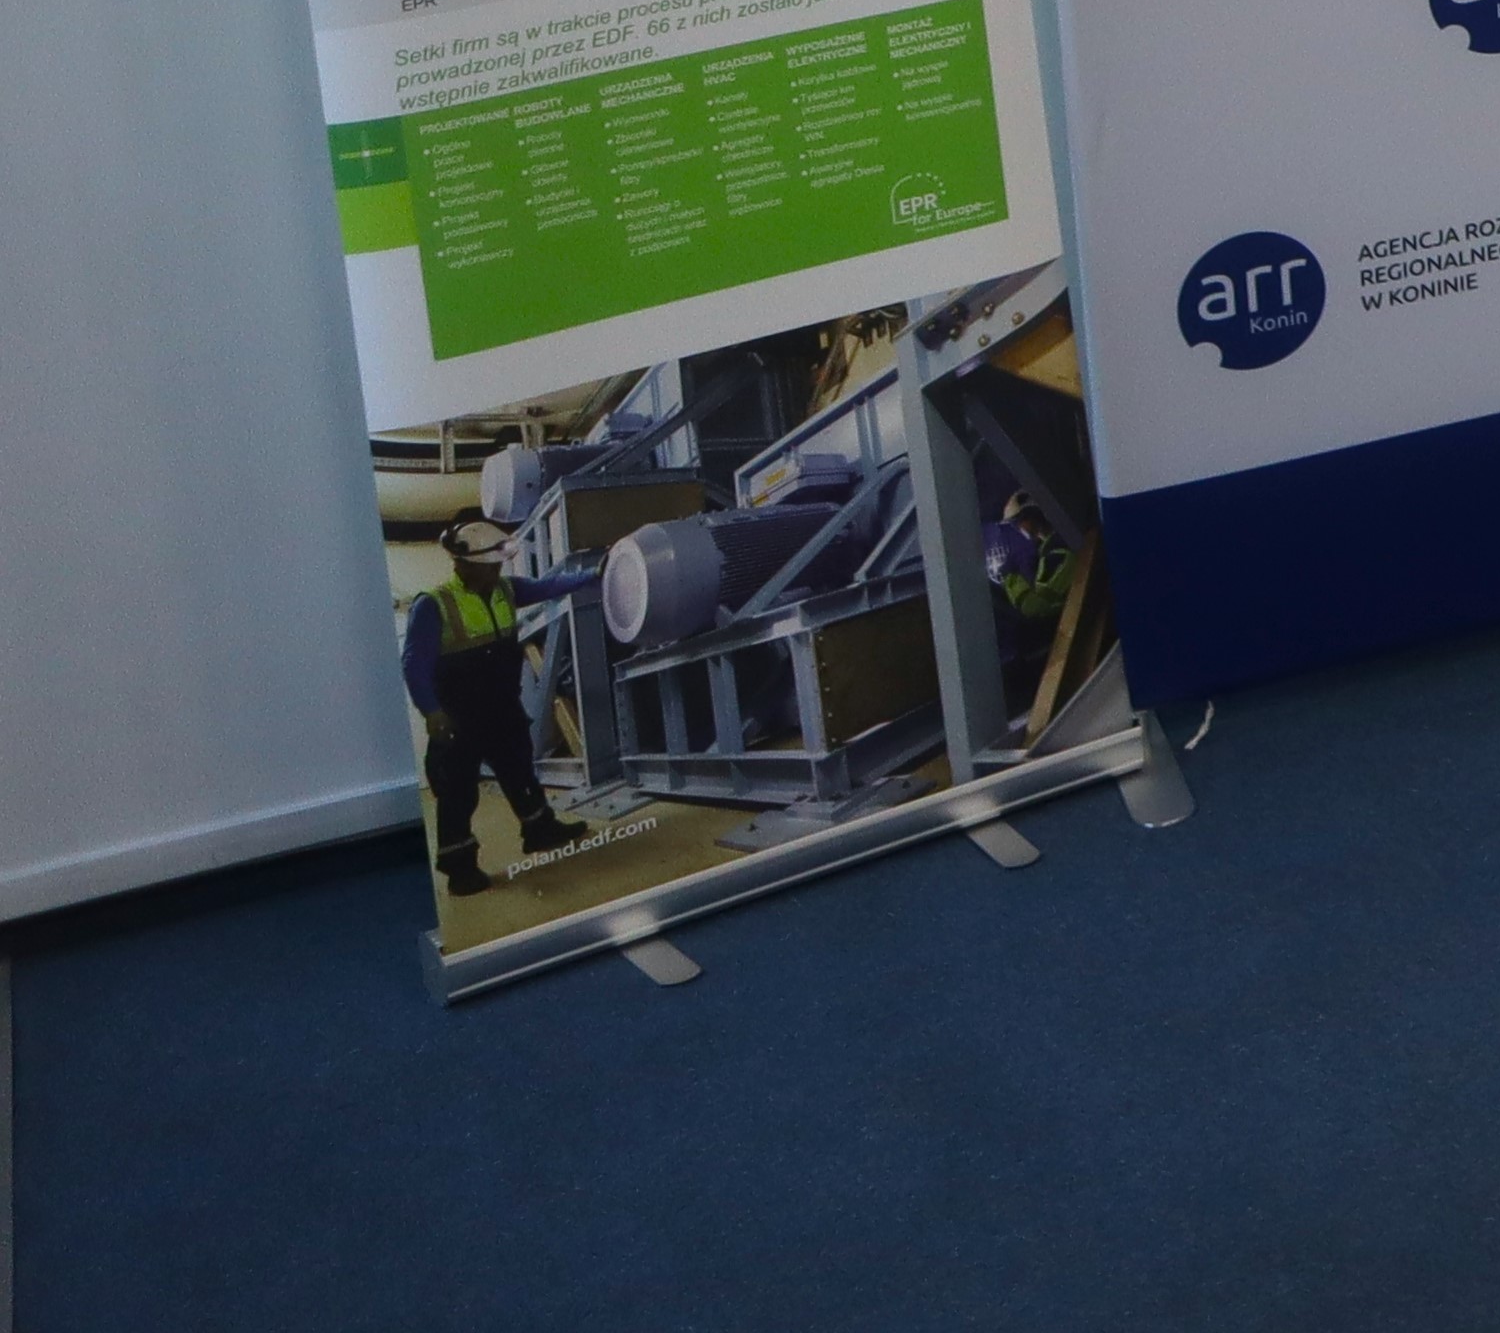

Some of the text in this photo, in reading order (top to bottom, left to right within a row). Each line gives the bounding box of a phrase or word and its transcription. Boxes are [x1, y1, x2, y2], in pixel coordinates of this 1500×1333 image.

[395, 45, 445, 68] Setki
[452, 36, 489, 56] firm
[495, 31, 520, 48] są
[525, 26, 542, 41] w
[547, 8, 610, 37] trakcie
[395, 51, 527, 92] prowadzonej
[532, 38, 586, 64] przez
[592, 25, 639, 49] EDF.
[647, 17, 671, 37] 66
[676, 17, 687, 31] z
[692, 5, 731, 28] nich
[400, 44, 660, 110] wstępnie zakwalifikowane.
[901, 194, 937, 216] EPR
[913, 214, 931, 225] for
[937, 201, 982, 221] Europe
[1198, 258, 1307, 321] arr
[507, 816, 657, 880] poland.edf.com
